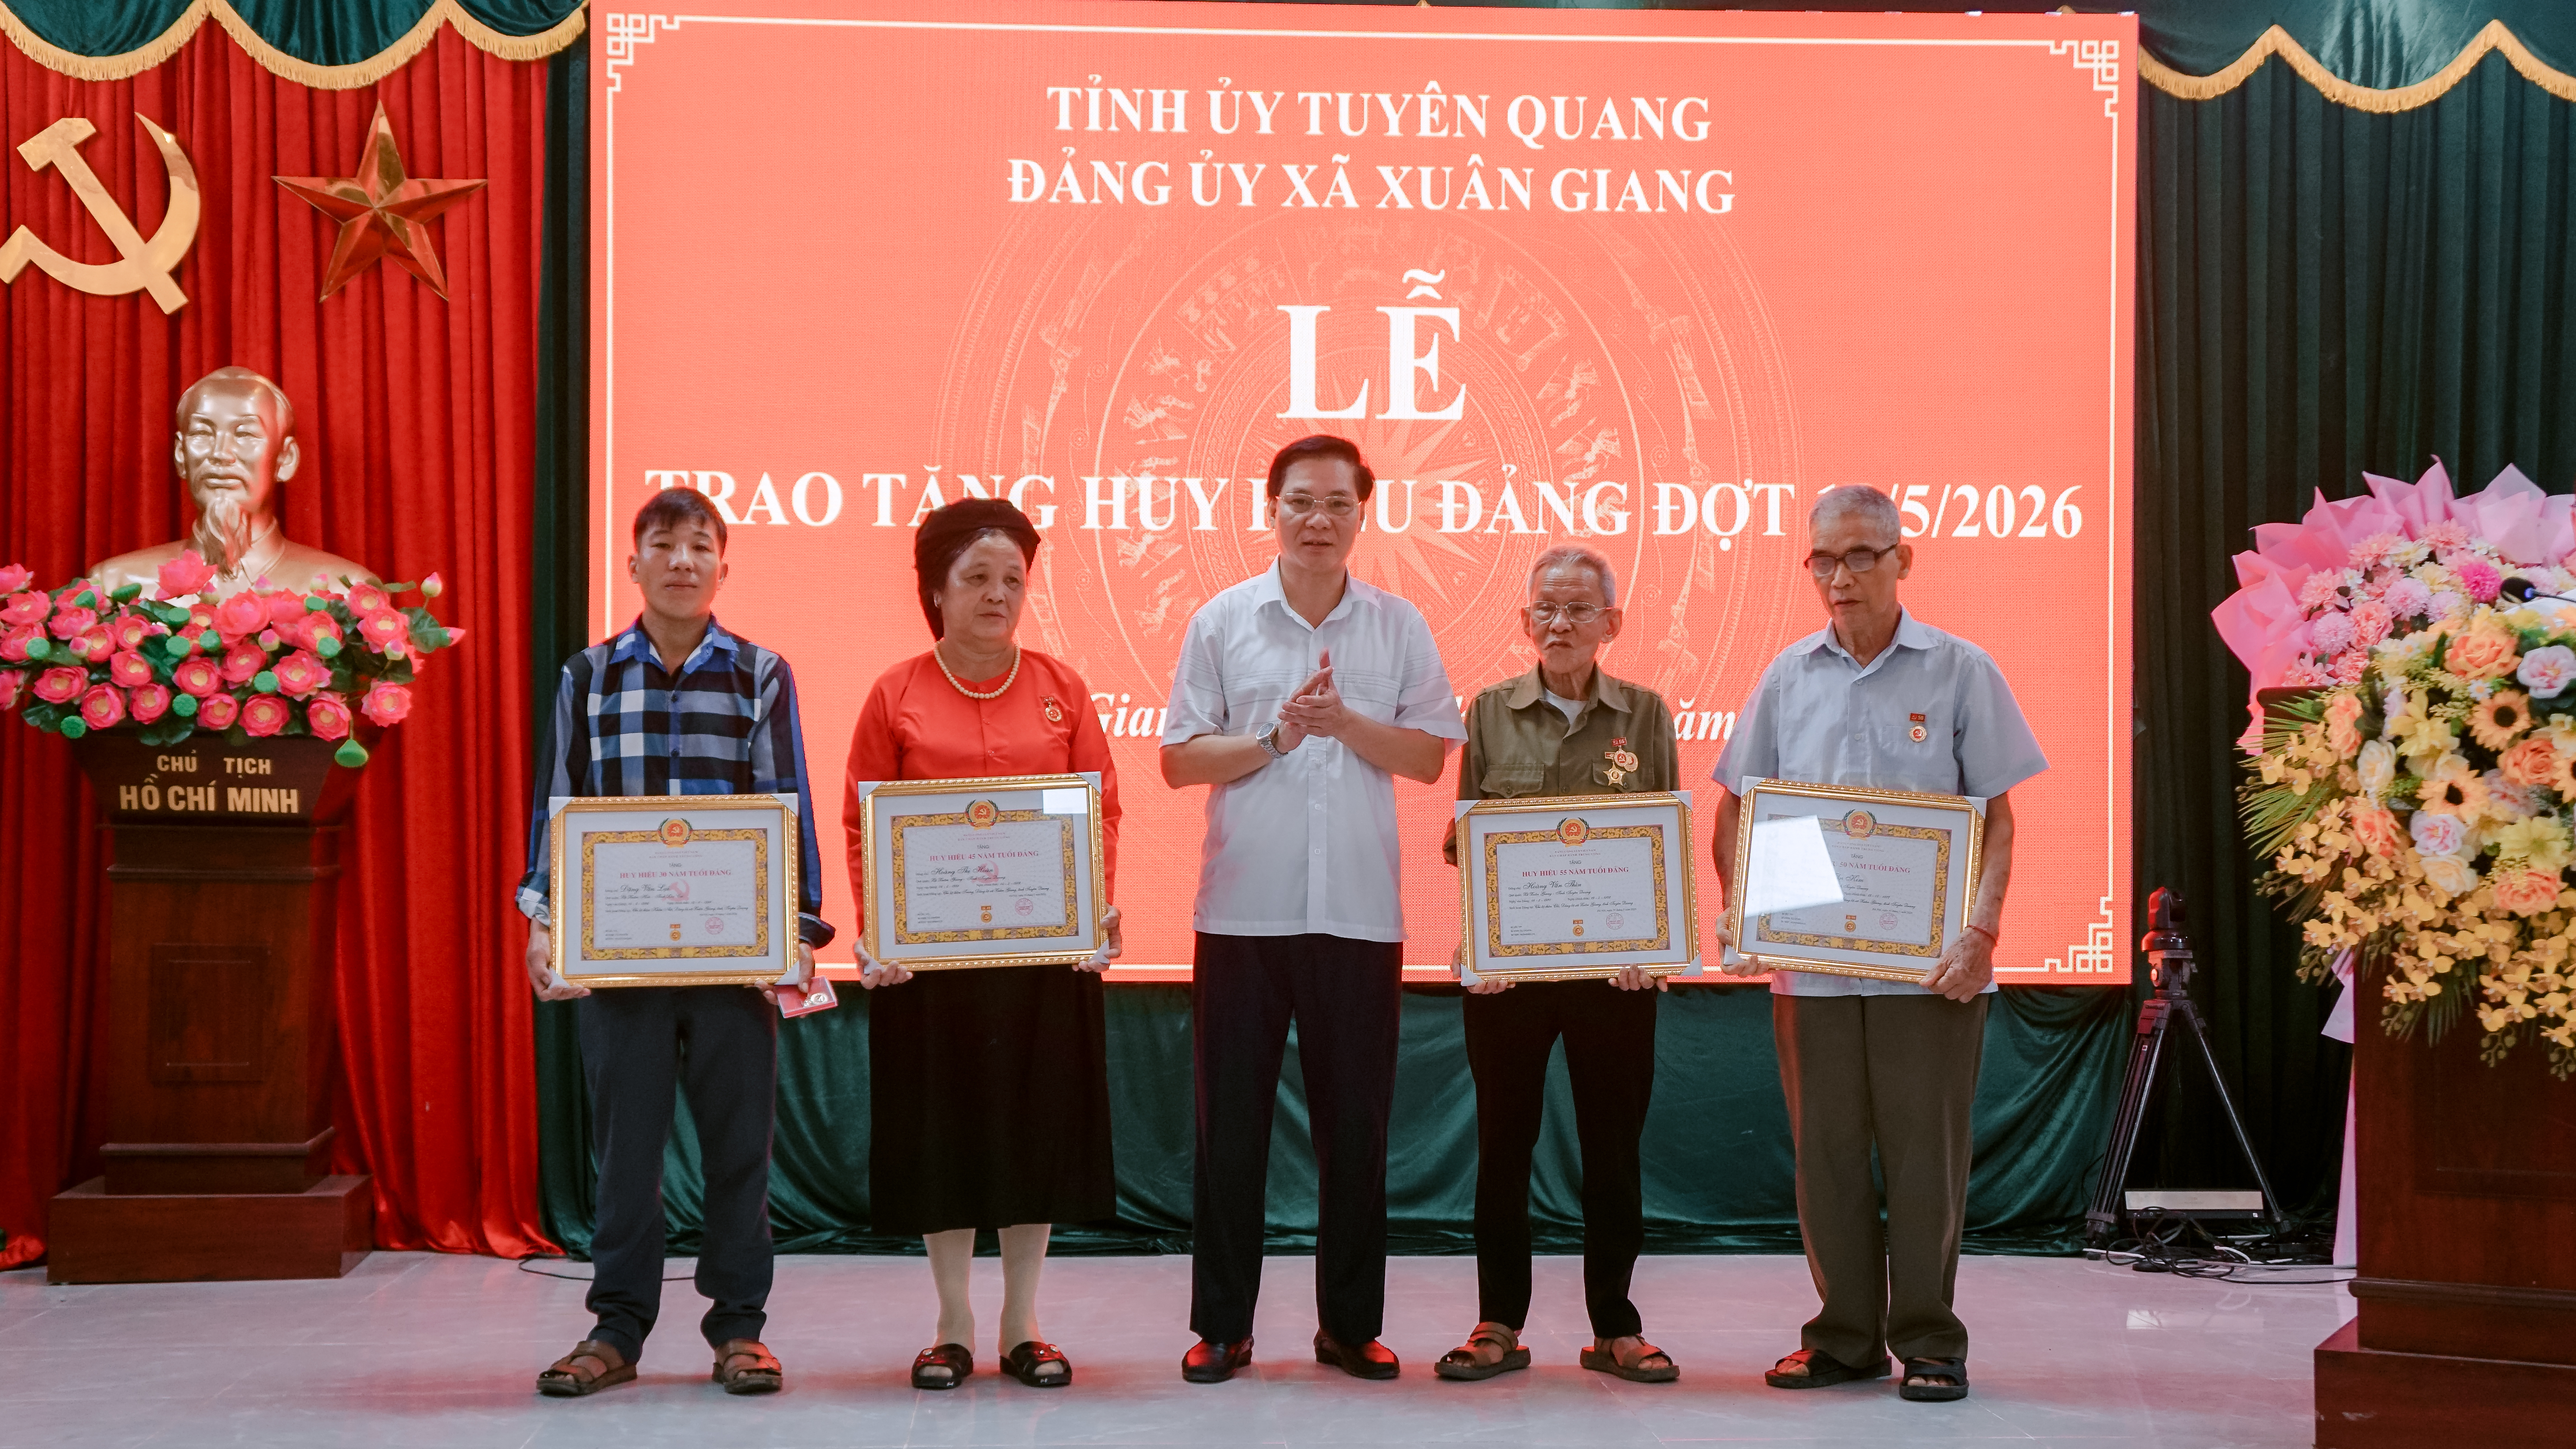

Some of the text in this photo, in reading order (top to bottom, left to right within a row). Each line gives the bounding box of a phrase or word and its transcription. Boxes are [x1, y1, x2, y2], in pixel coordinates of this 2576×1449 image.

[1047, 75, 1712, 150] TỈNH ỦY TUYÊN QUANG
[1008, 146, 1736, 214] ĐẢNG ỦY XÃ XUÂN GIANG
[1276, 269, 1467, 421] LỄ
[1079, 476, 1229, 531] HUY
[1435, 464, 1632, 536] ĐẢNG
[1652, 478, 1796, 552] ĐỢT
[1817, 483, 2083, 538] 5/2026
[1674, 697, 1736, 741] ăm
[157, 749, 272, 778] CHỦ TỊCH
[119, 774, 298, 813] HỒ CHÍ MINH
[997, 850, 1015, 858] TUỔI
[1540, 869, 1558, 877] HIỆU
[1587, 865, 1606, 874] TUỔI
[1868, 863, 1887, 871] TUỔI
[1888, 865, 1911, 873] ĐẢNG
